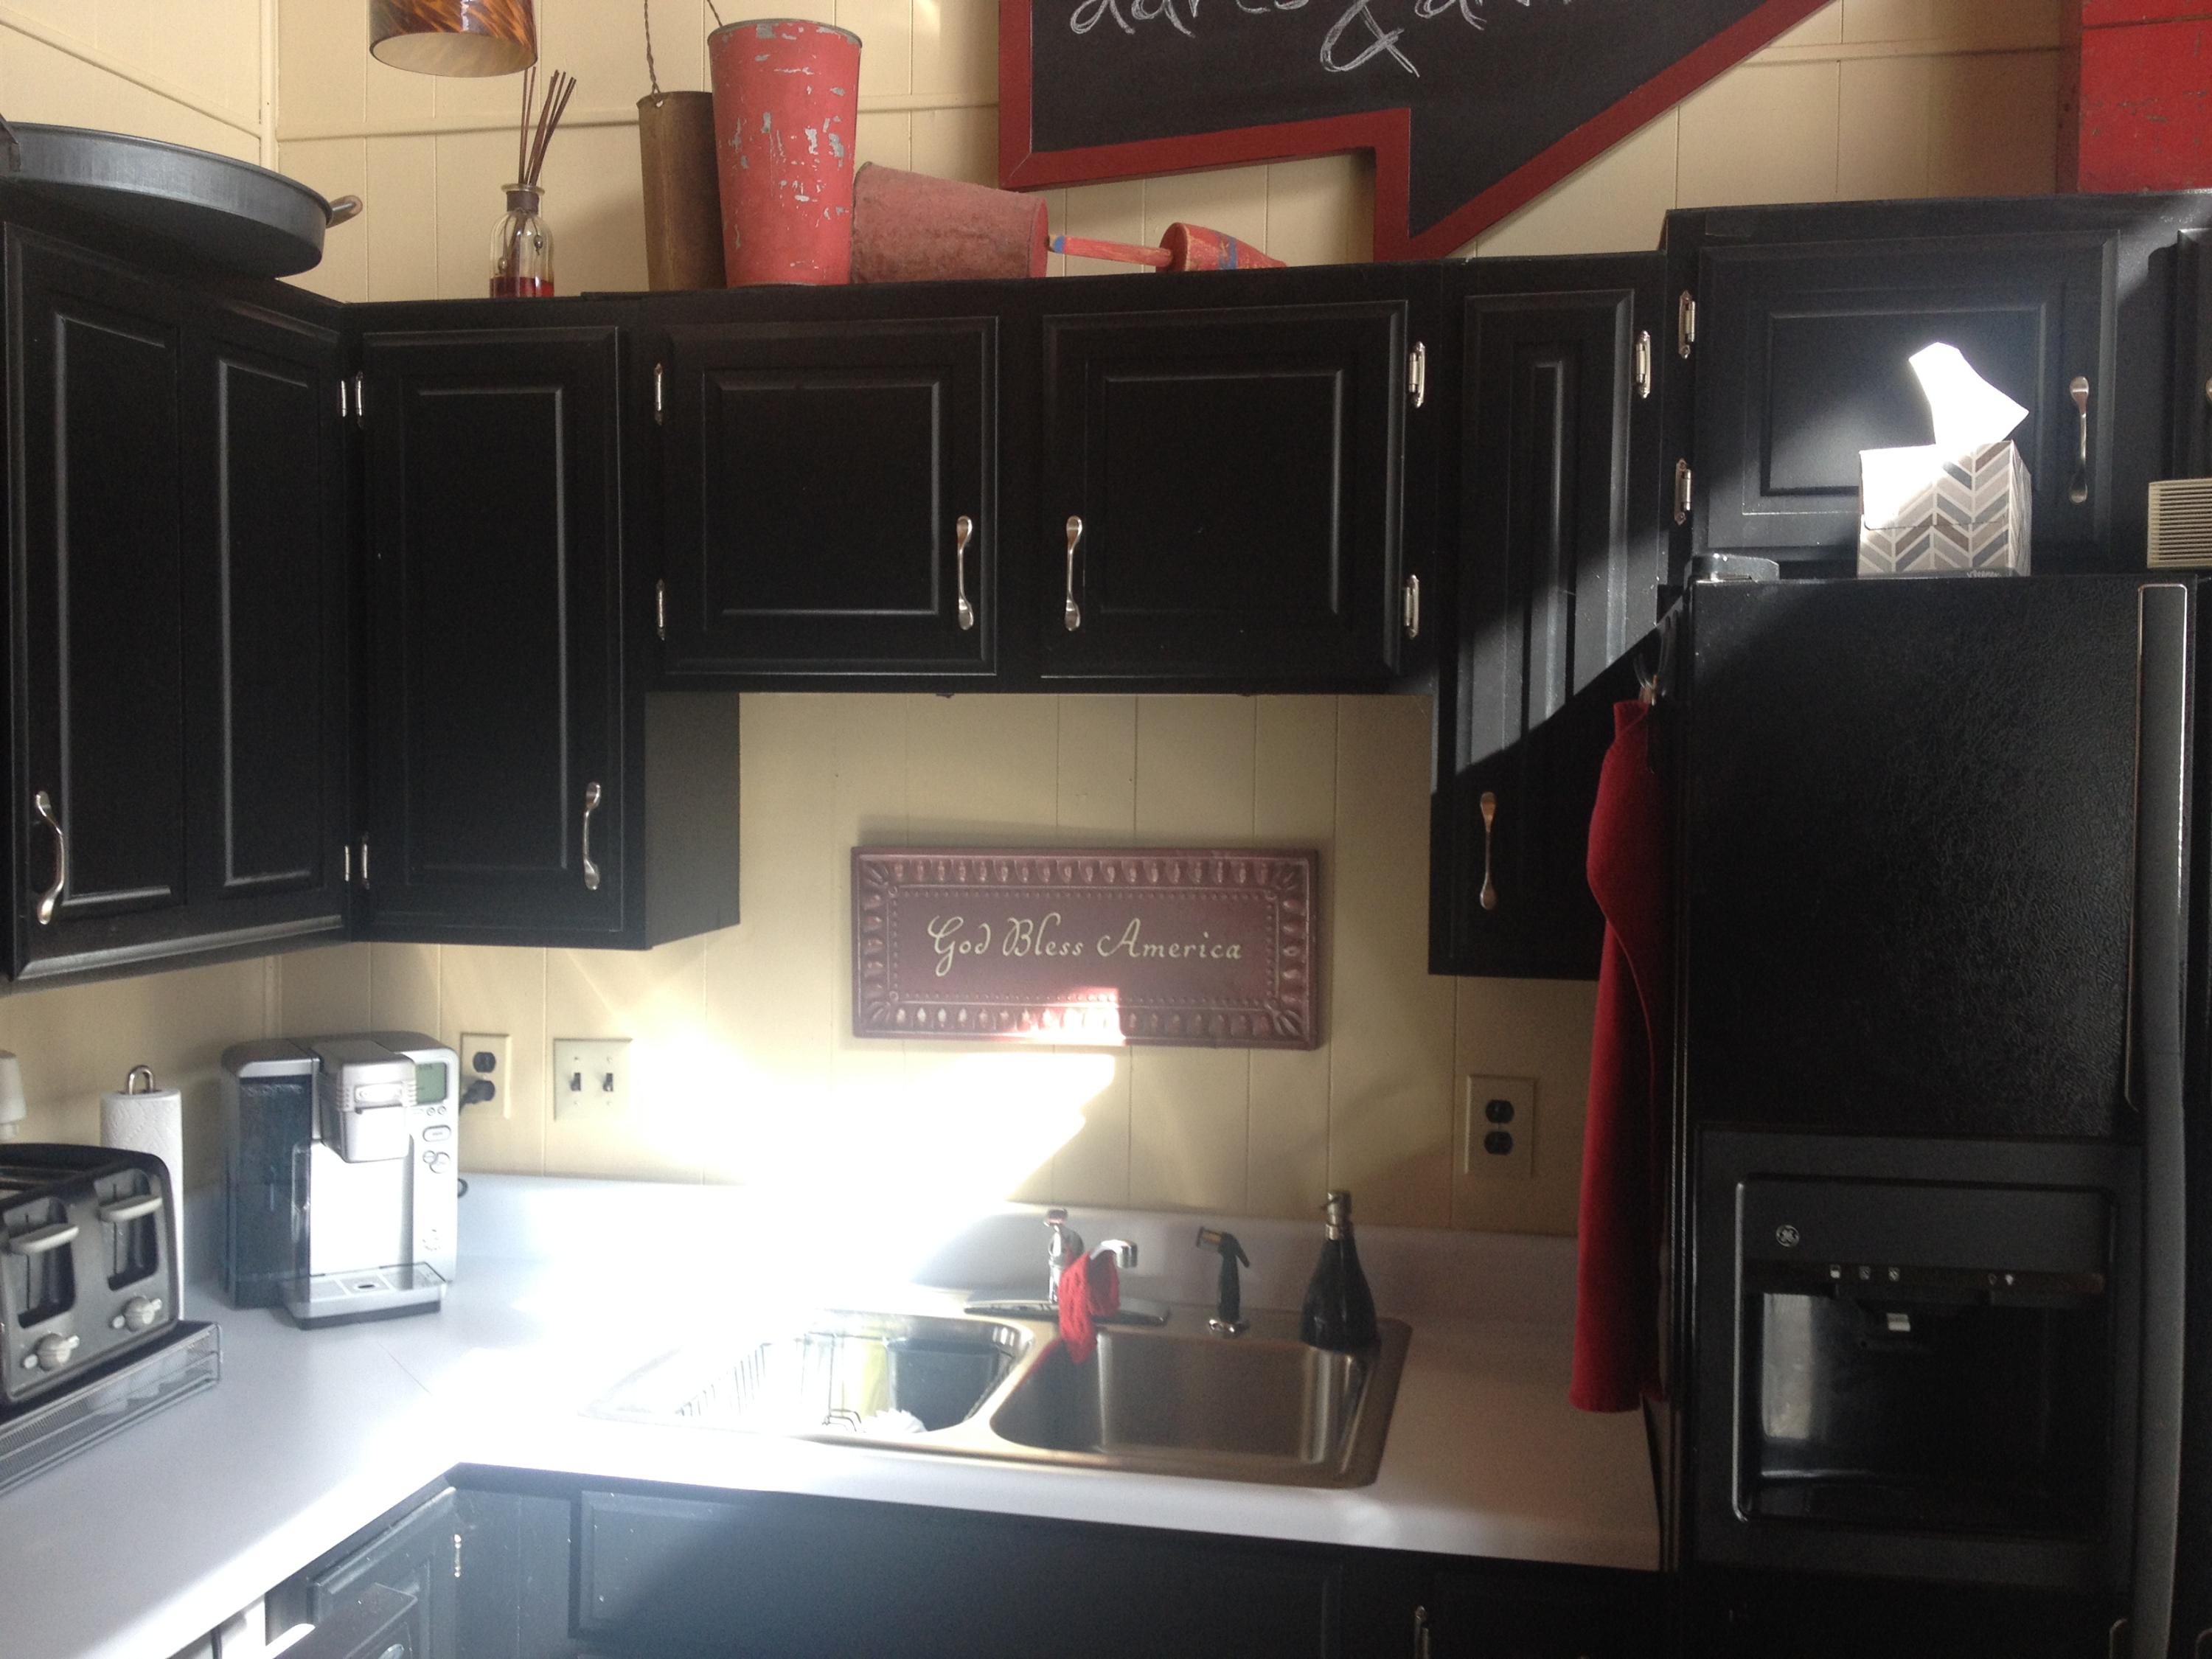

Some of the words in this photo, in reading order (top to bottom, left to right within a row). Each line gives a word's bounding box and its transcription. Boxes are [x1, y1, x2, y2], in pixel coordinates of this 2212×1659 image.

[926, 914, 992, 978] God
[1001, 911, 1085, 958] Bless
[1096, 917, 1242, 960] America
